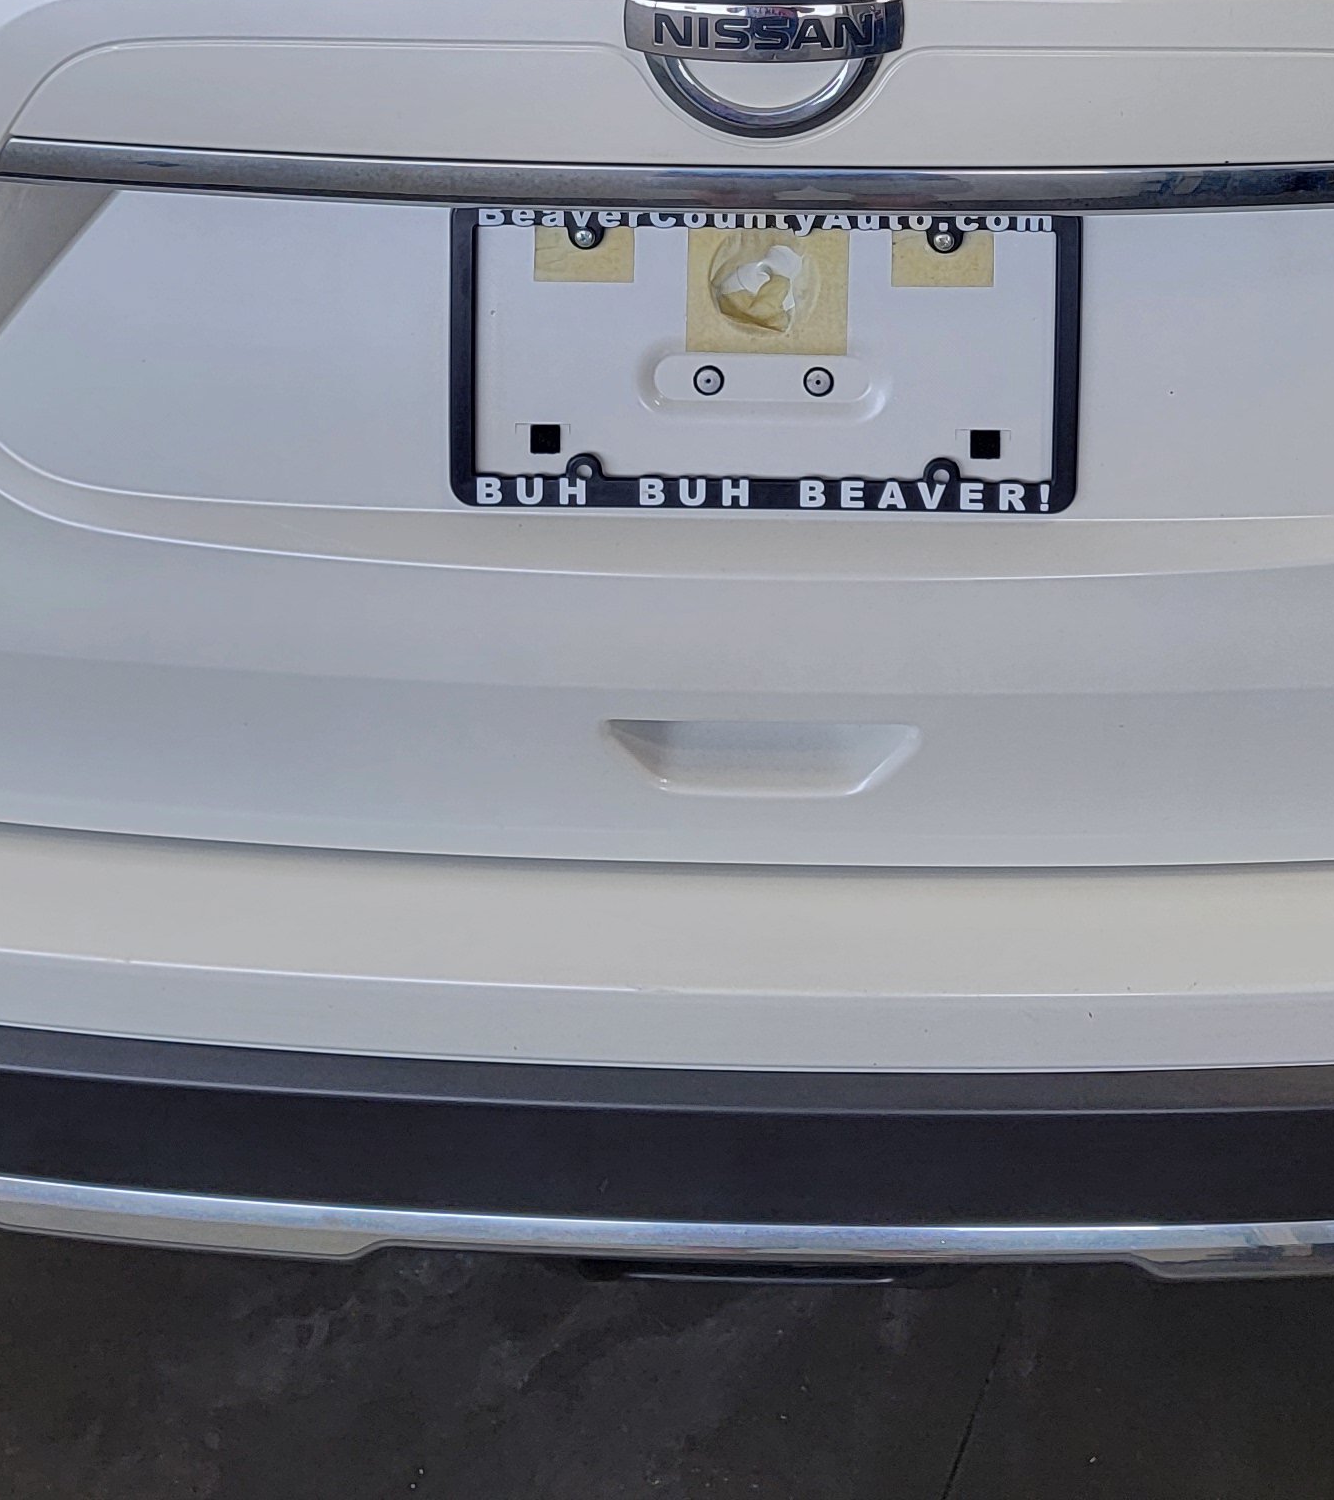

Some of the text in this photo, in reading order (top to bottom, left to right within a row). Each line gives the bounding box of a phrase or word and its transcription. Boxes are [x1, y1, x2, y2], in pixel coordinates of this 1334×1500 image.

[654, 13, 875, 50] NISSAN
[476, 477, 1052, 512] BUH BUH BEAVER!
